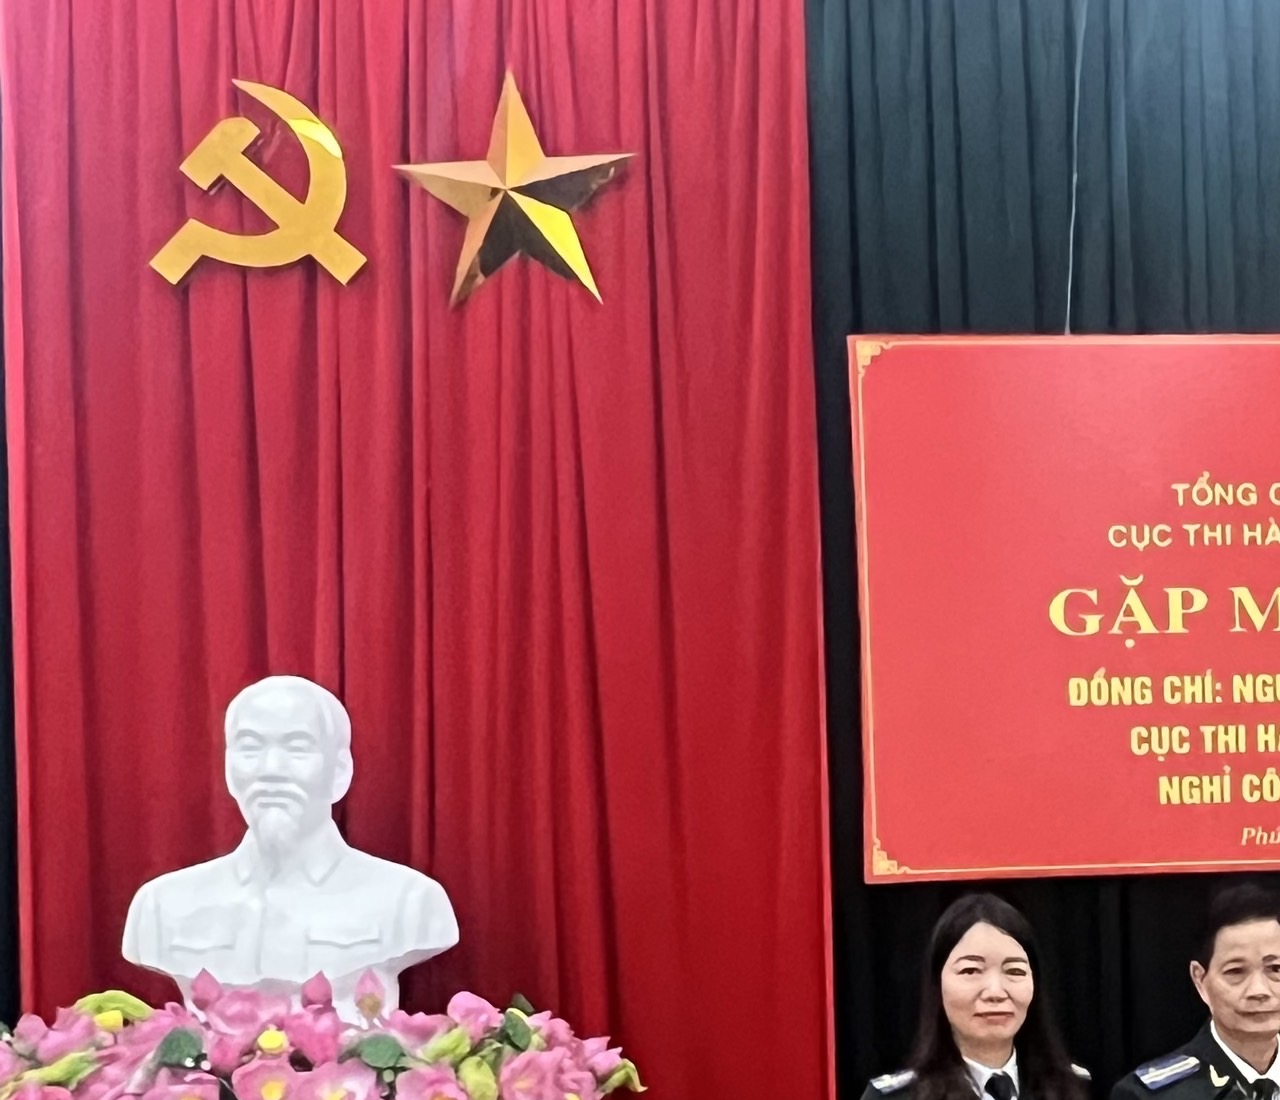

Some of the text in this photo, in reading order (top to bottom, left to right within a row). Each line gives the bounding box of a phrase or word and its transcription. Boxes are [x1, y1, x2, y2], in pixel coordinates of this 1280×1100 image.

[1170, 470, 1258, 507] TỔNG
[1107, 523, 1173, 552] CỤC
[1181, 523, 1232, 547] THI
[1048, 573, 1209, 649] GẶP
[1067, 666, 1154, 707] ĐỒNG
[1162, 668, 1223, 705] CHÍ:
[1130, 725, 1191, 762] CỤC
[1199, 724, 1247, 754] THI
[1158, 764, 1232, 805] NGHỈ
